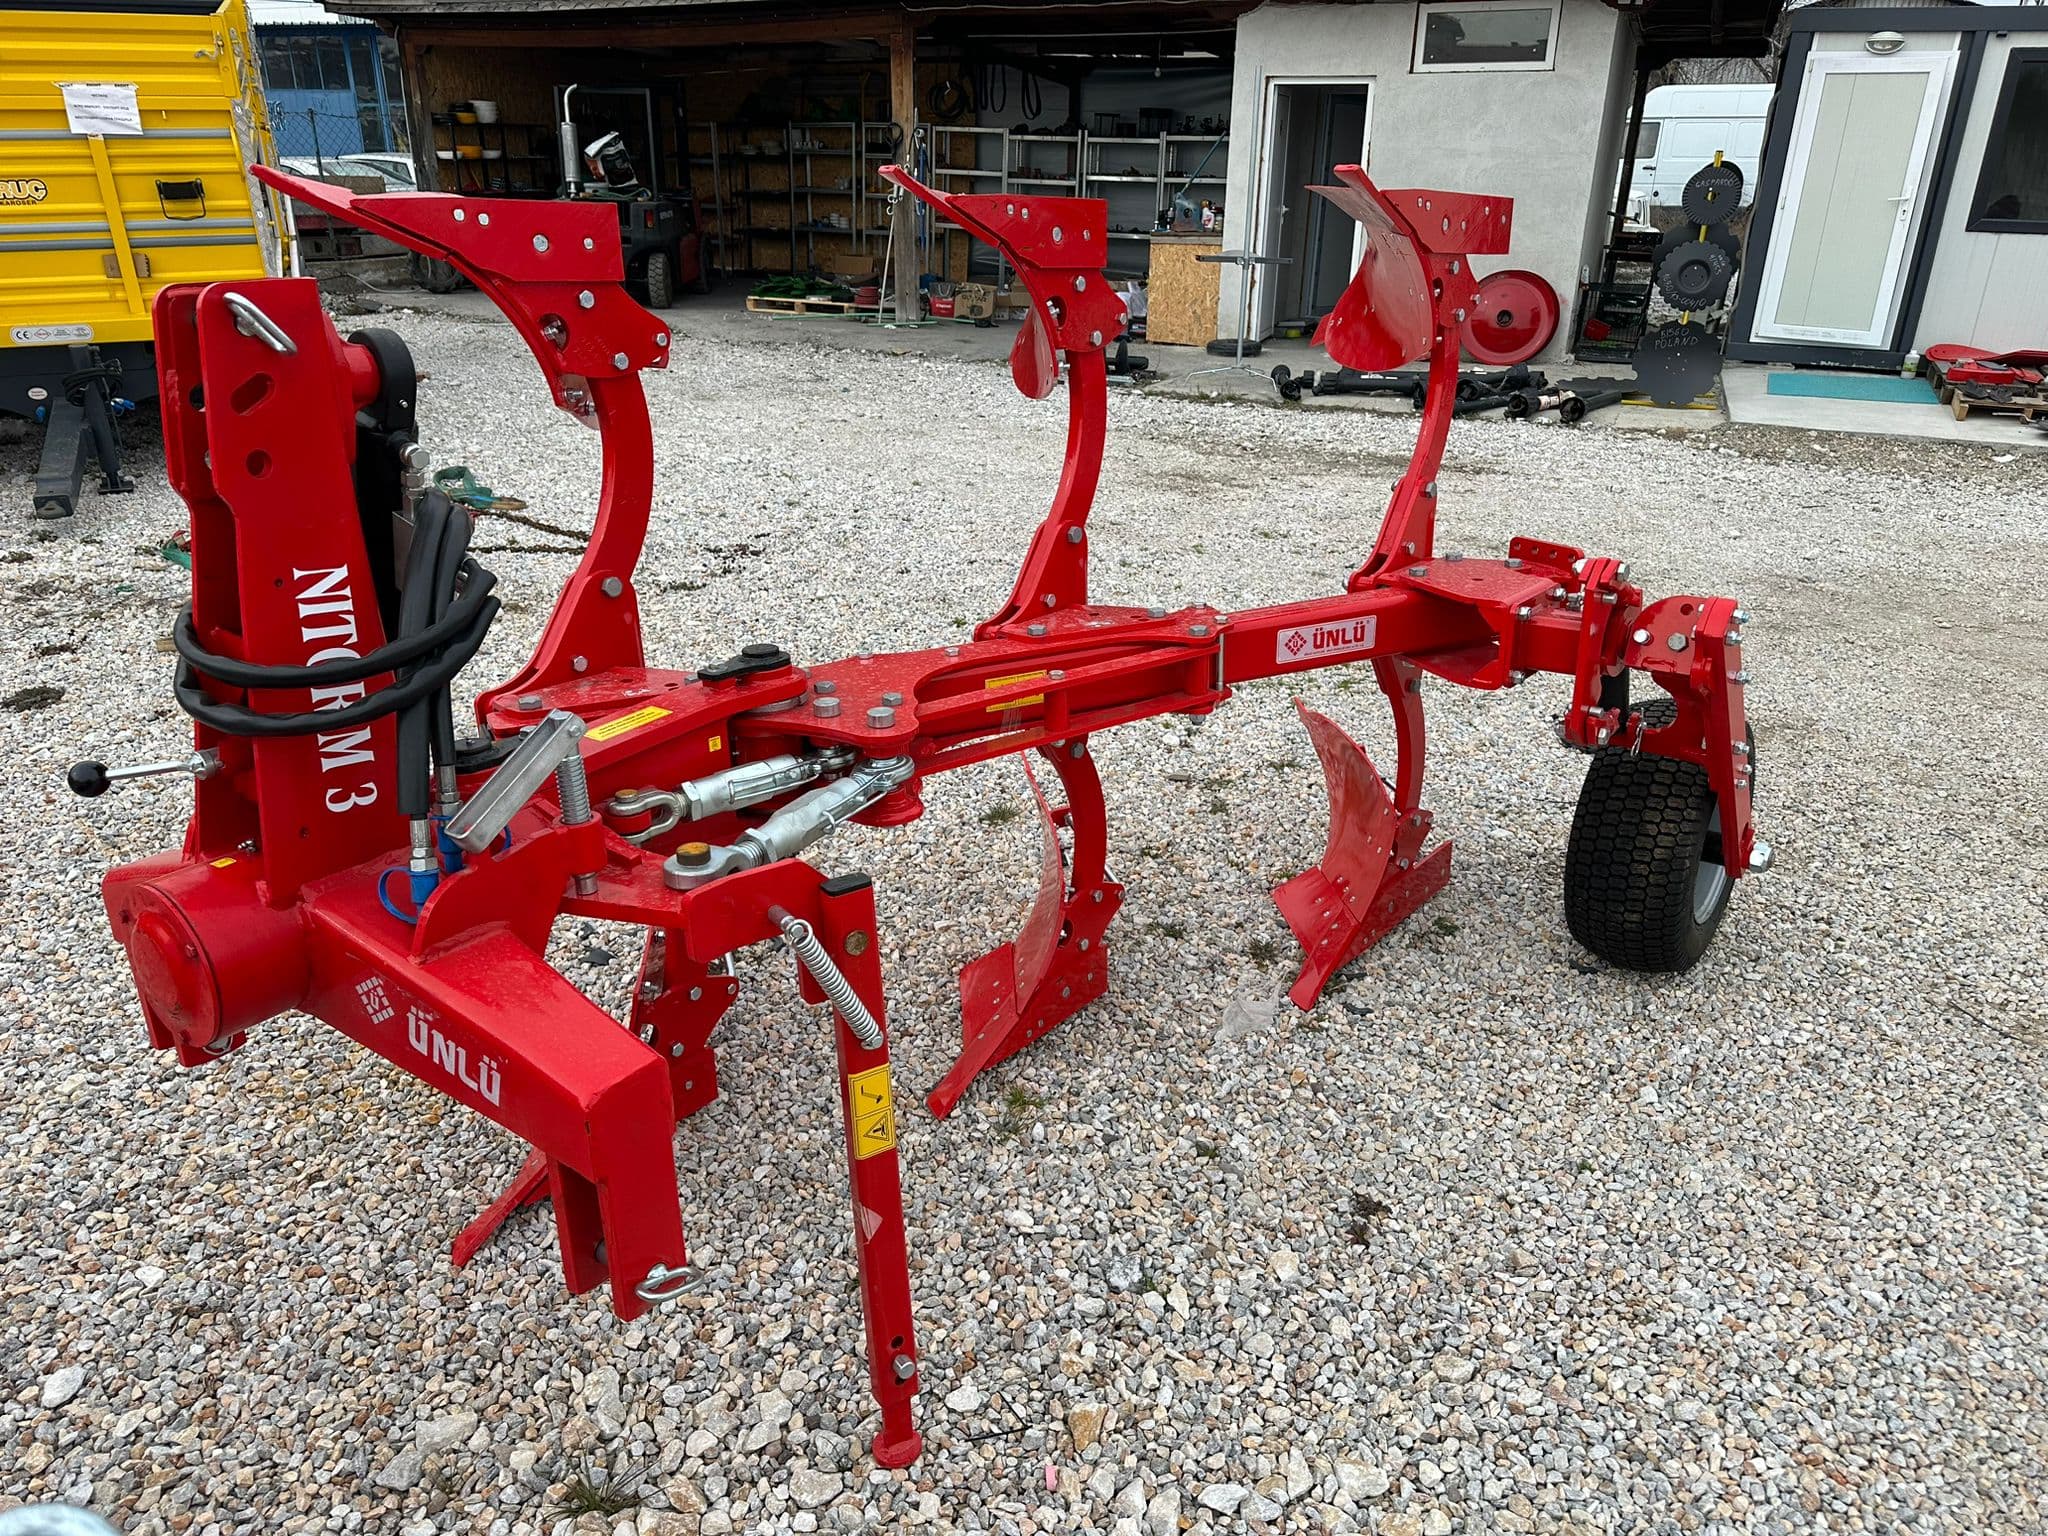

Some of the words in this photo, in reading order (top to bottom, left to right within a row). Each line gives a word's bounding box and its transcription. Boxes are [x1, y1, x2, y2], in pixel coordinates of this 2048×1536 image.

[1655, 336, 1698, 350] POLAND
[1313, 621, 1366, 650] ÜNLÜ
[325, 782, 378, 813] 3
[406, 1005, 501, 1107] ÜNLÜ
